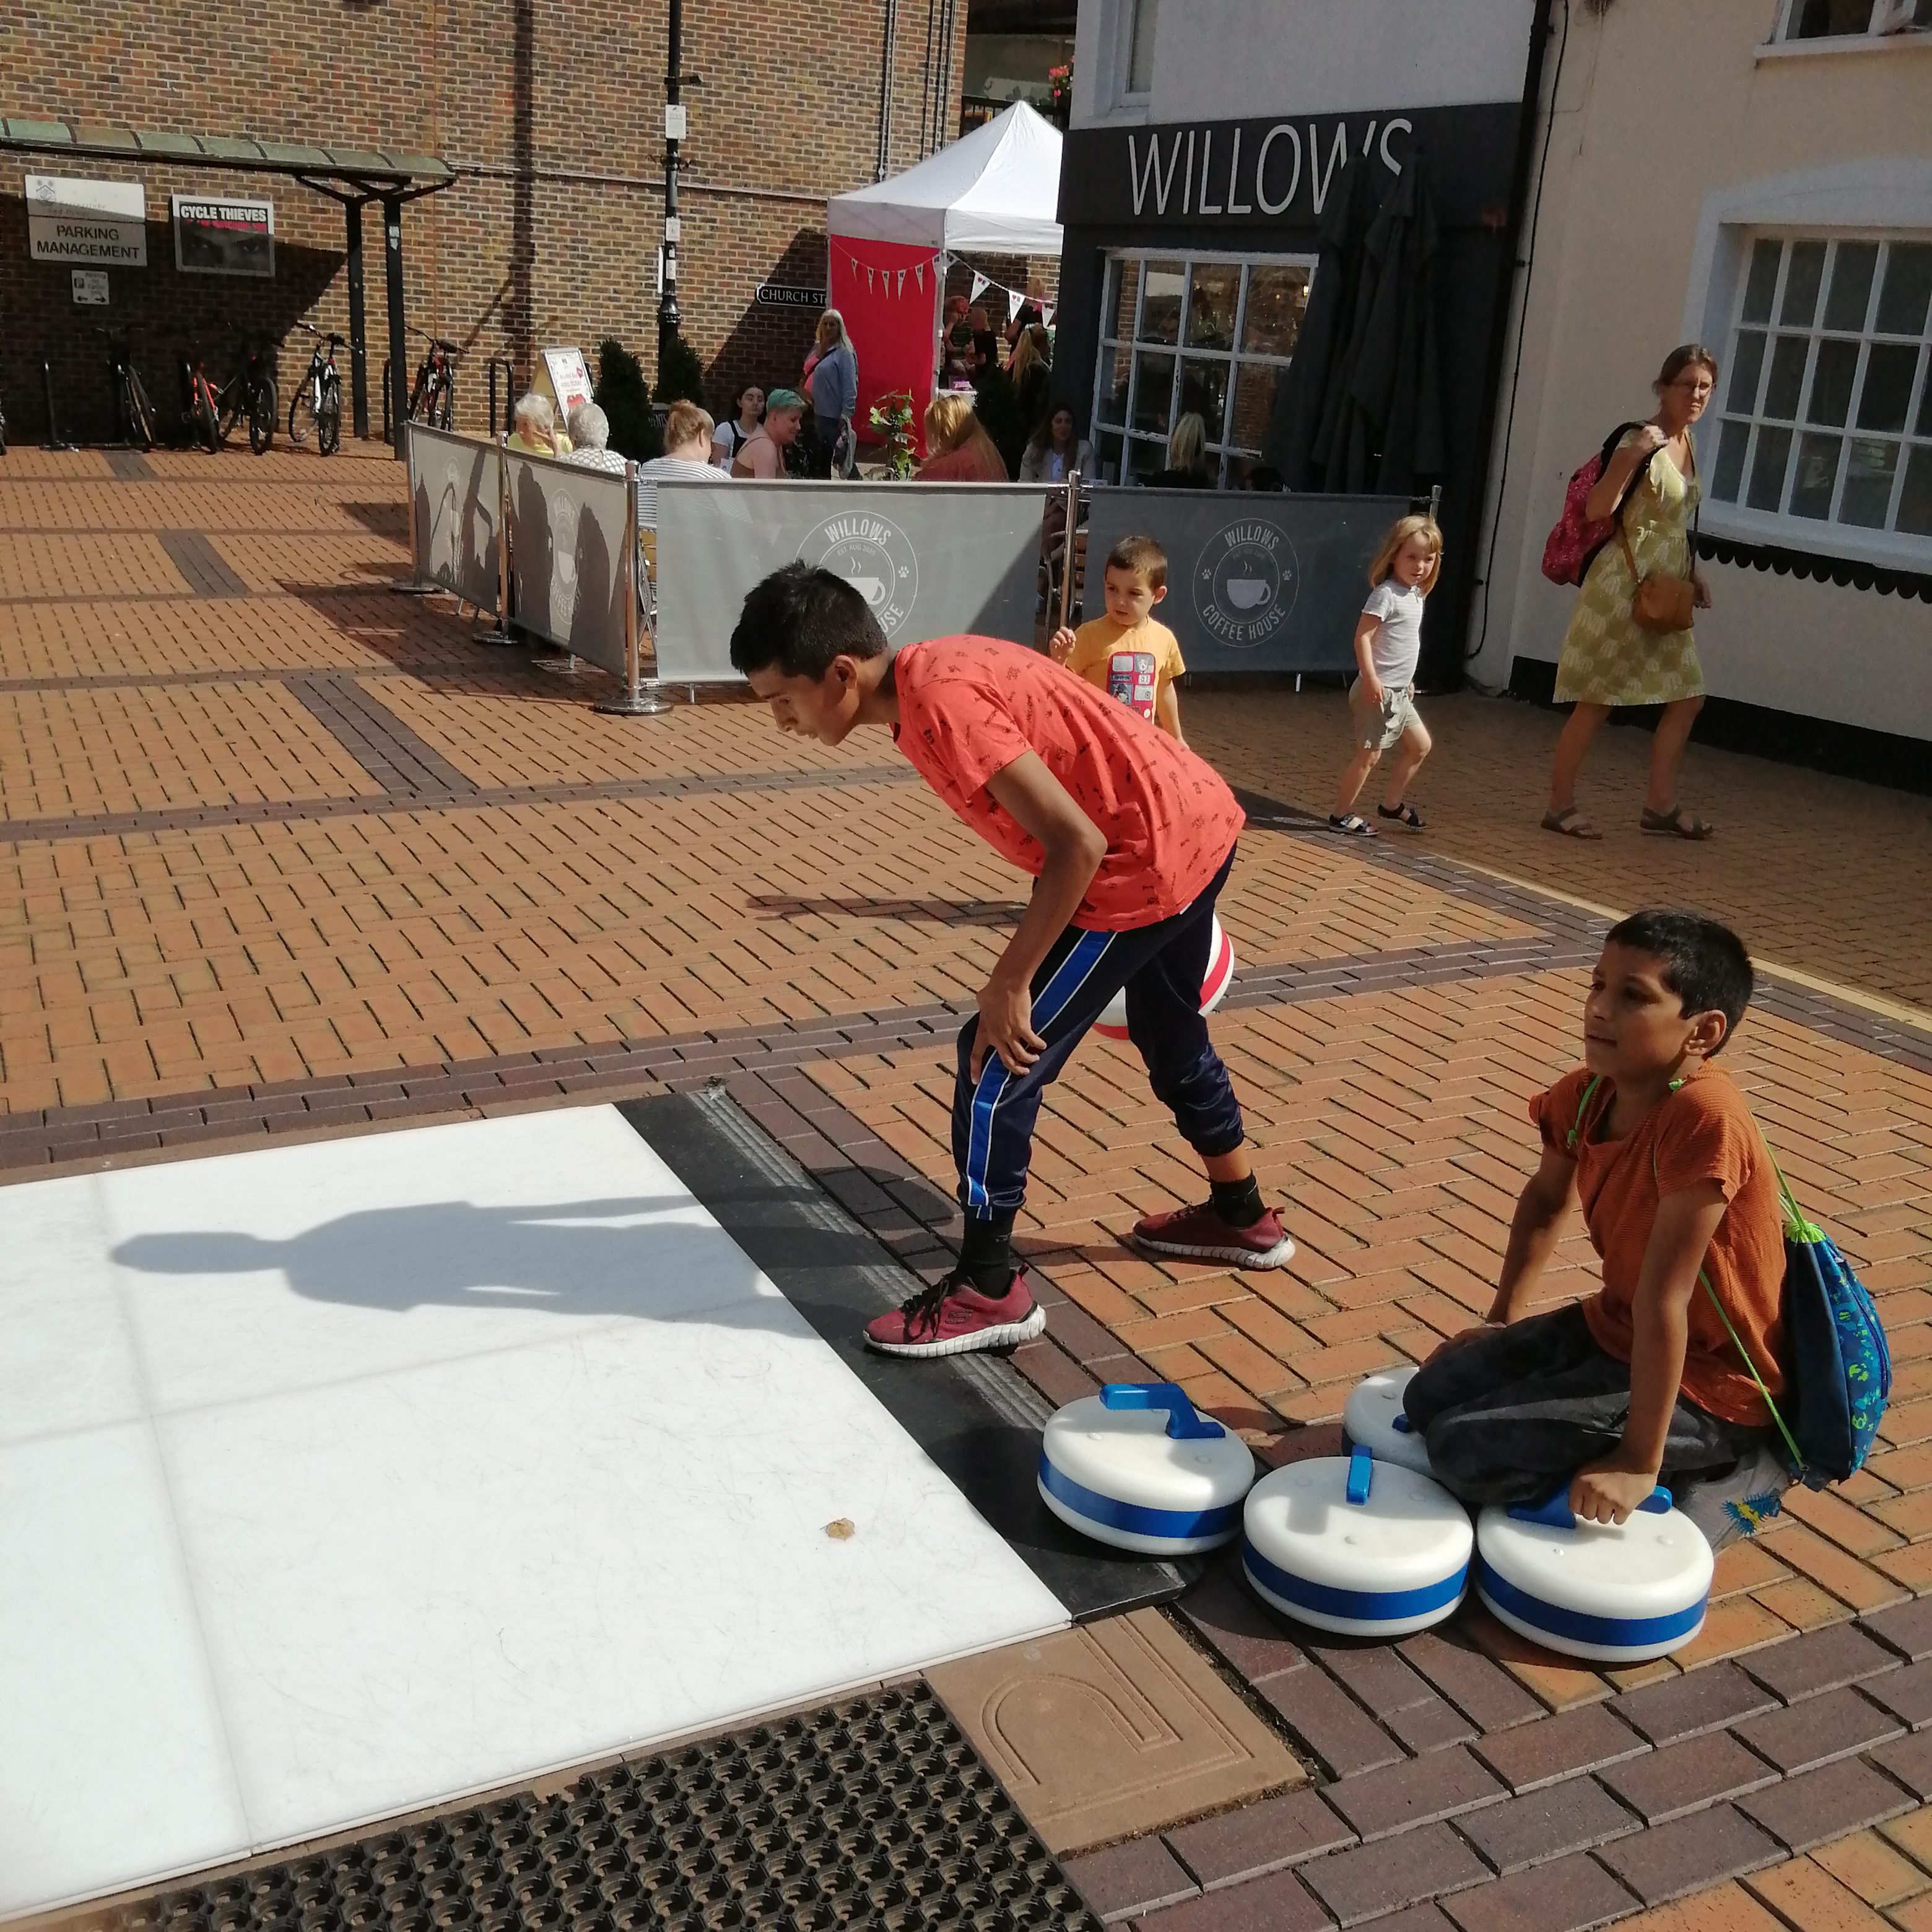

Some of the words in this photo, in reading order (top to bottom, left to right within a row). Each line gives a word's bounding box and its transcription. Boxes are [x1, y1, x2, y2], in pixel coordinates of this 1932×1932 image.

[181, 206, 217, 219] CYCLE
[219, 207, 266, 222] THIEVES
[56, 225, 119, 240] PARKING
[37, 240, 139, 259] MANAGEMENT
[760, 289, 808, 303] CHURCH
[812, 293, 827, 304] ST
[825, 518, 891, 546] WILLOWS
[1224, 525, 1279, 550] WILLOWS
[876, 603, 904, 633] USE
[1203, 604, 1243, 641] COFFEE
[1248, 604, 1286, 640] HOUSE
